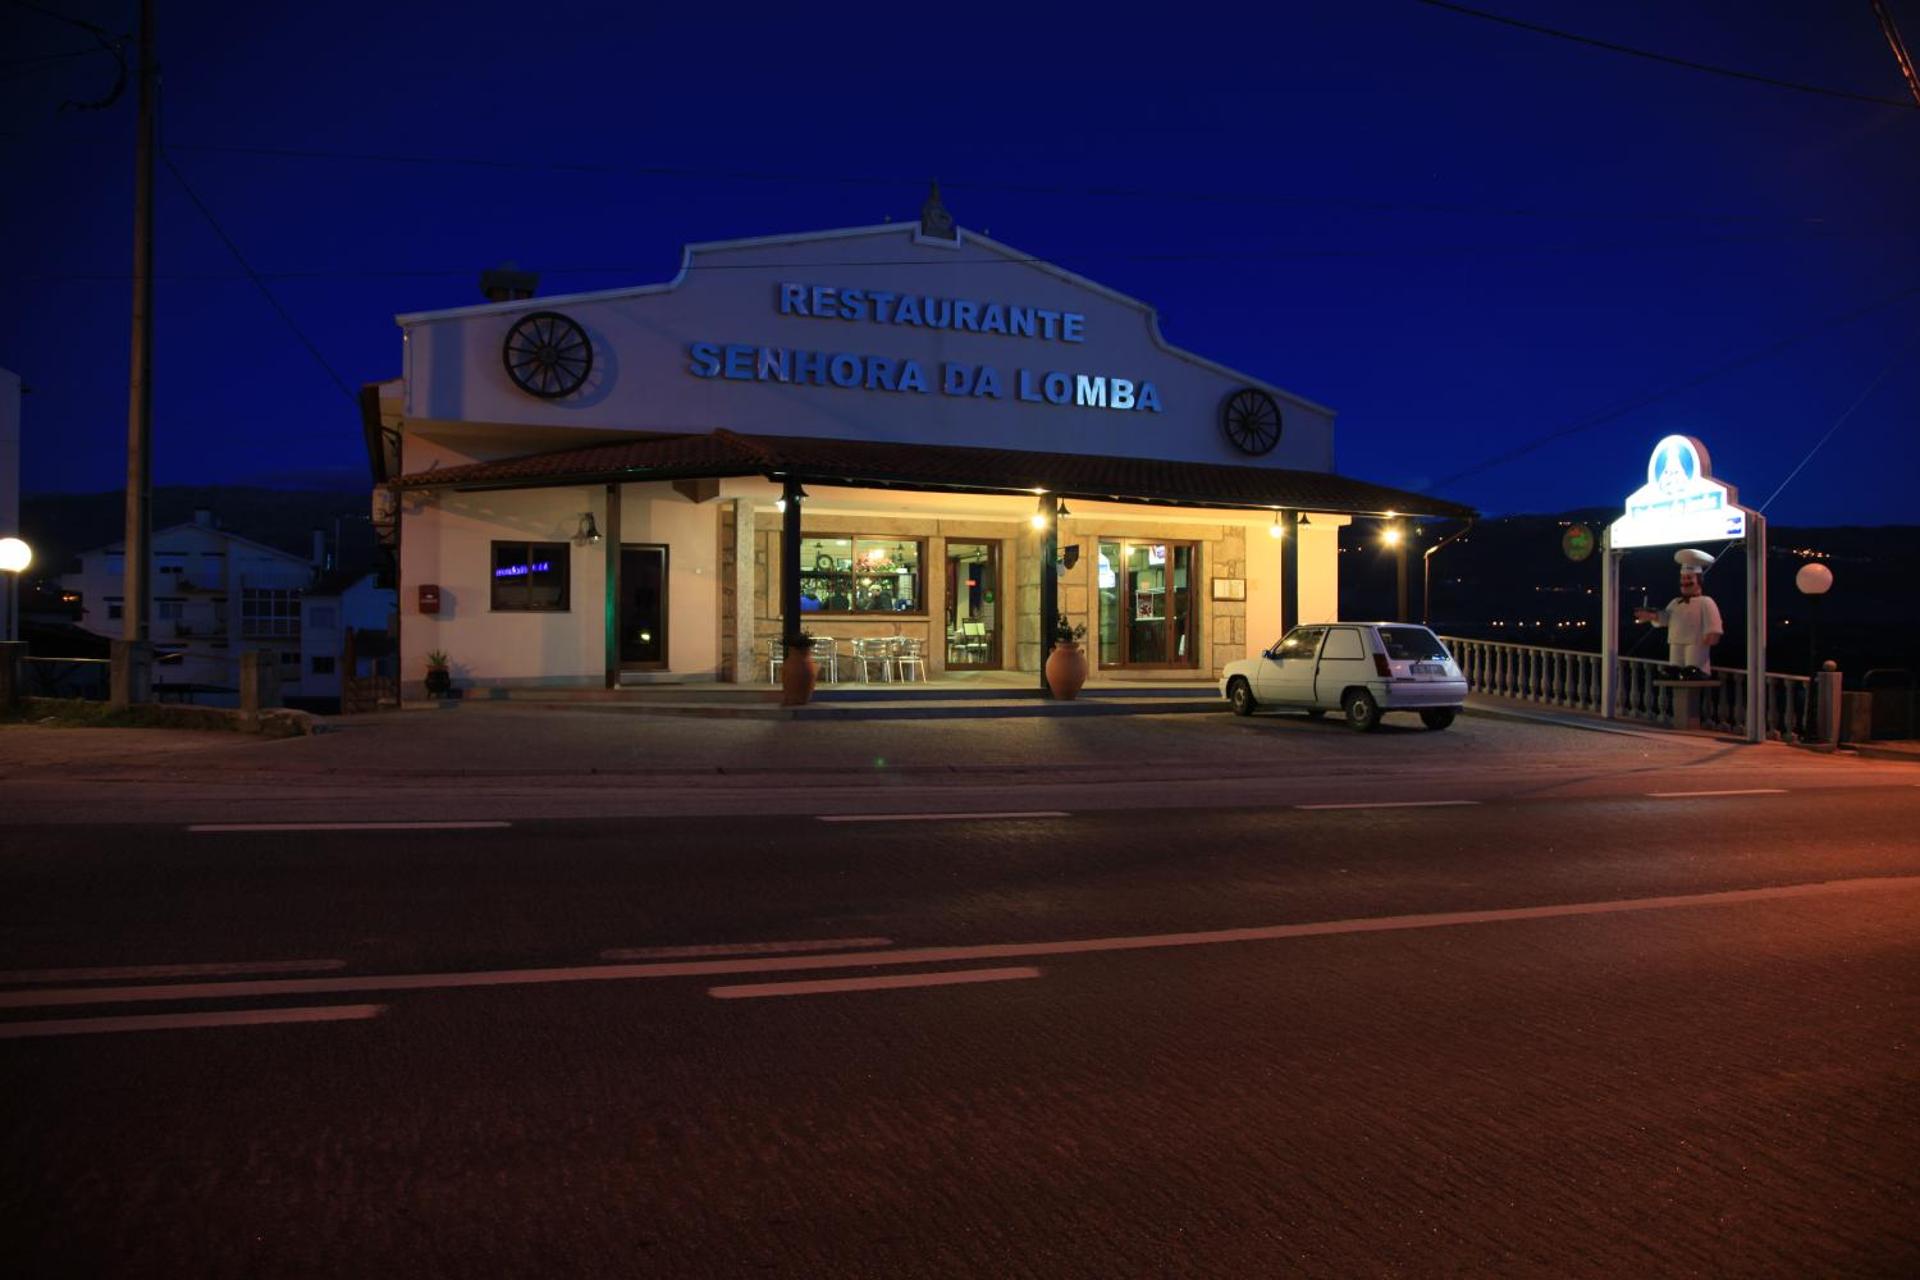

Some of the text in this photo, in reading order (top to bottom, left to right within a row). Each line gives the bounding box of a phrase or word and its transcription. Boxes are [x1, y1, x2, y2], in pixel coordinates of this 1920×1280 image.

[778, 281, 1085, 344] RESTAURANTE
[688, 341, 1163, 413] SENHORA DA LOMBA
